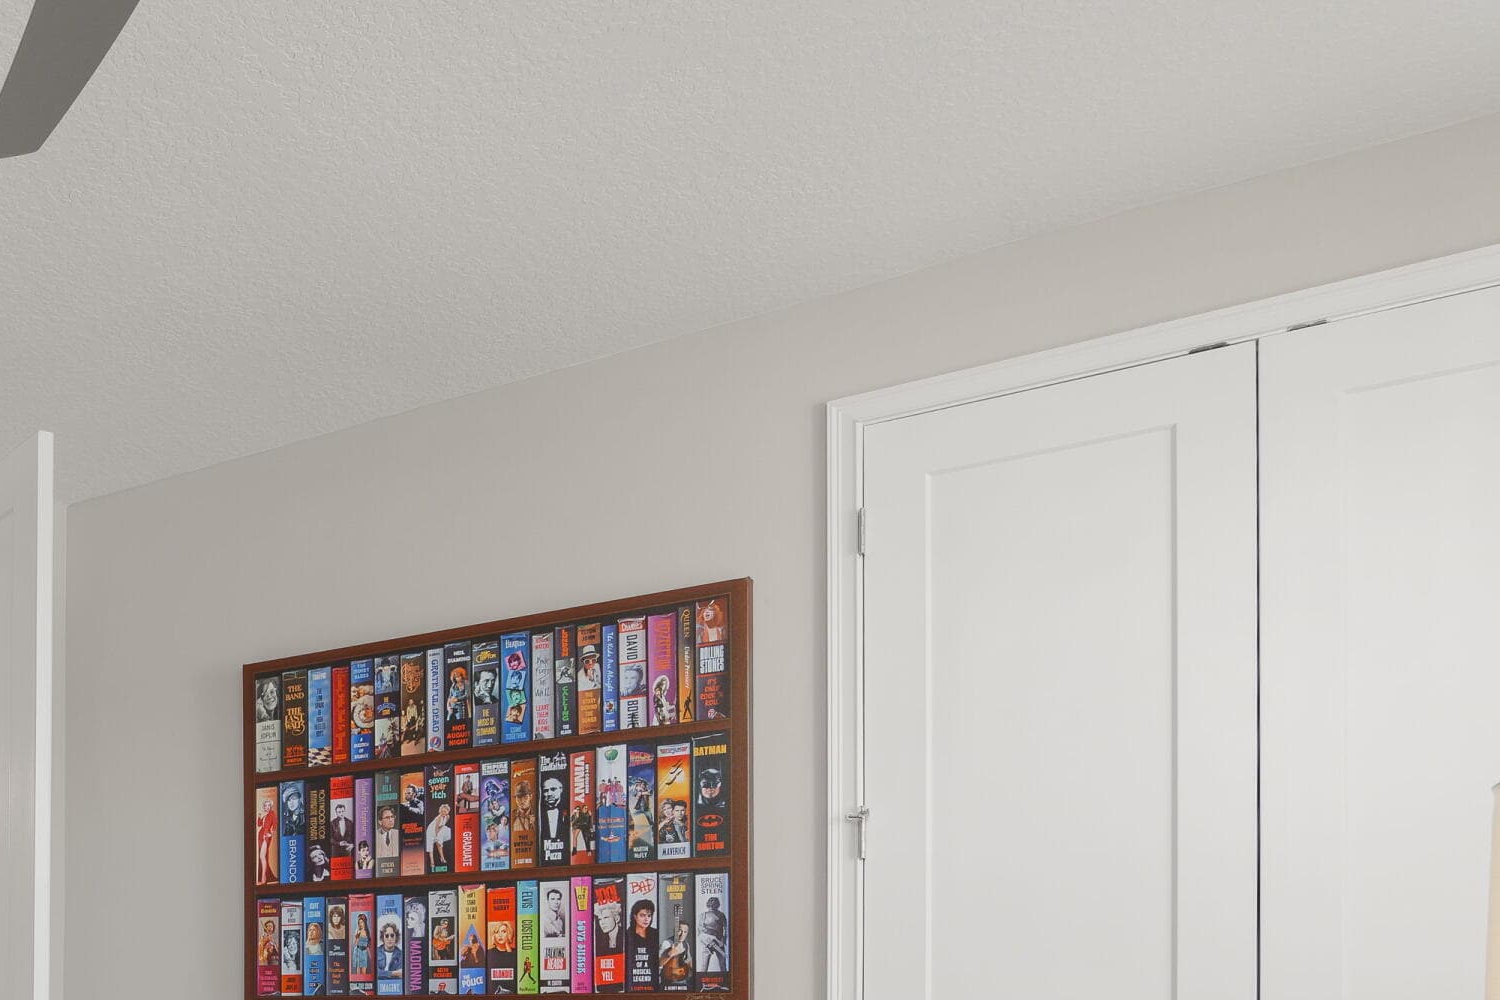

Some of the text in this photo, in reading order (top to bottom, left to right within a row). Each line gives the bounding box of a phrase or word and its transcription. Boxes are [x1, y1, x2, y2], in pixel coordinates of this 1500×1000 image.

[681, 608, 691, 638] QUEEN
[626, 634, 638, 660] DAVID
[700, 645, 724, 660] ROLLING
[700, 658, 724, 674] STONES
[431, 659, 439, 706] GRATEFUL
[285, 693, 305, 701] BAND
[287, 707, 302, 715] THE
[627, 700, 640, 728] BOWIE
[431, 708, 440, 733] DEAD
[447, 731, 471, 739] AUGUST
[693, 744, 727, 757] BATMAN
[541, 755, 551, 763] The
[540, 762, 567, 772] Godfather
[429, 776, 450, 786] seven
[574, 755, 585, 803] VINNY
[430, 783, 446, 792] year
[432, 790, 447, 799] itch
[462, 817, 472, 867] THE GRADUATE
[704, 833, 717, 841] TIM
[544, 839, 564, 851] Mario
[697, 841, 725, 851] BURTON
[662, 847, 686, 856] MAVERICK
[289, 839, 297, 883] BRANDO
[630, 878, 655, 895] BAD
[521, 891, 533, 950] ELVIS COSTELLO
[576, 920, 587, 943] LOVE
[545, 947, 565, 959] TALKING
[576, 944, 587, 974] SHACK
[409, 940, 422, 992] MADONNA
[546, 958, 564, 970] HEADS
[600, 958, 615, 969] REBEL
[461, 975, 484, 988] POLICE
[601, 971, 614, 981] YELL
[380, 983, 400, 993] IMAGINE
